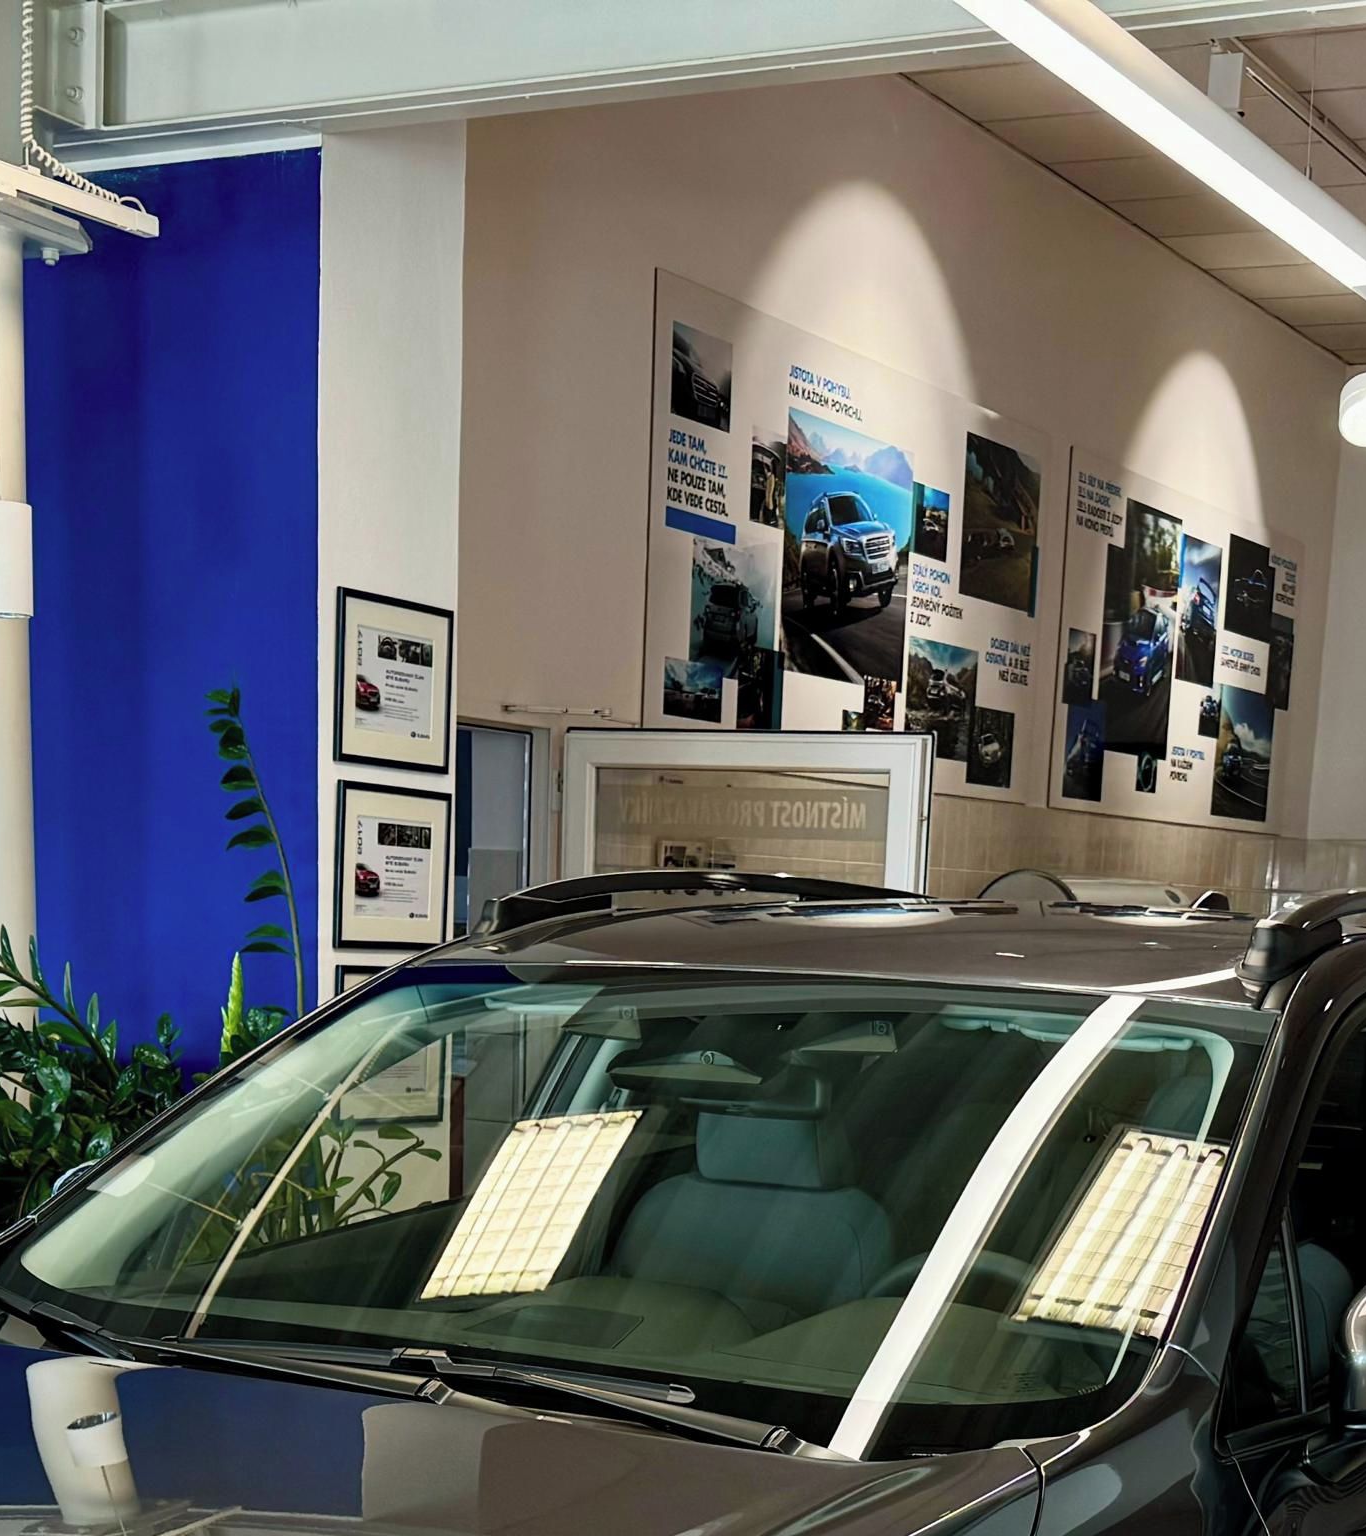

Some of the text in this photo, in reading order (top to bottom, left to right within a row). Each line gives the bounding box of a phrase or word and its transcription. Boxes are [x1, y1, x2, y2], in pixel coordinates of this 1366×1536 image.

[789, 382, 799, 398] NA
[668, 429, 707, 455] JEDE TAM,
[668, 447, 688, 466] KAM
[689, 455, 717, 476] CHCETE
[667, 467, 726, 499] NE POUZE TAM,
[667, 486, 729, 517] KDE VEDE CESTA.
